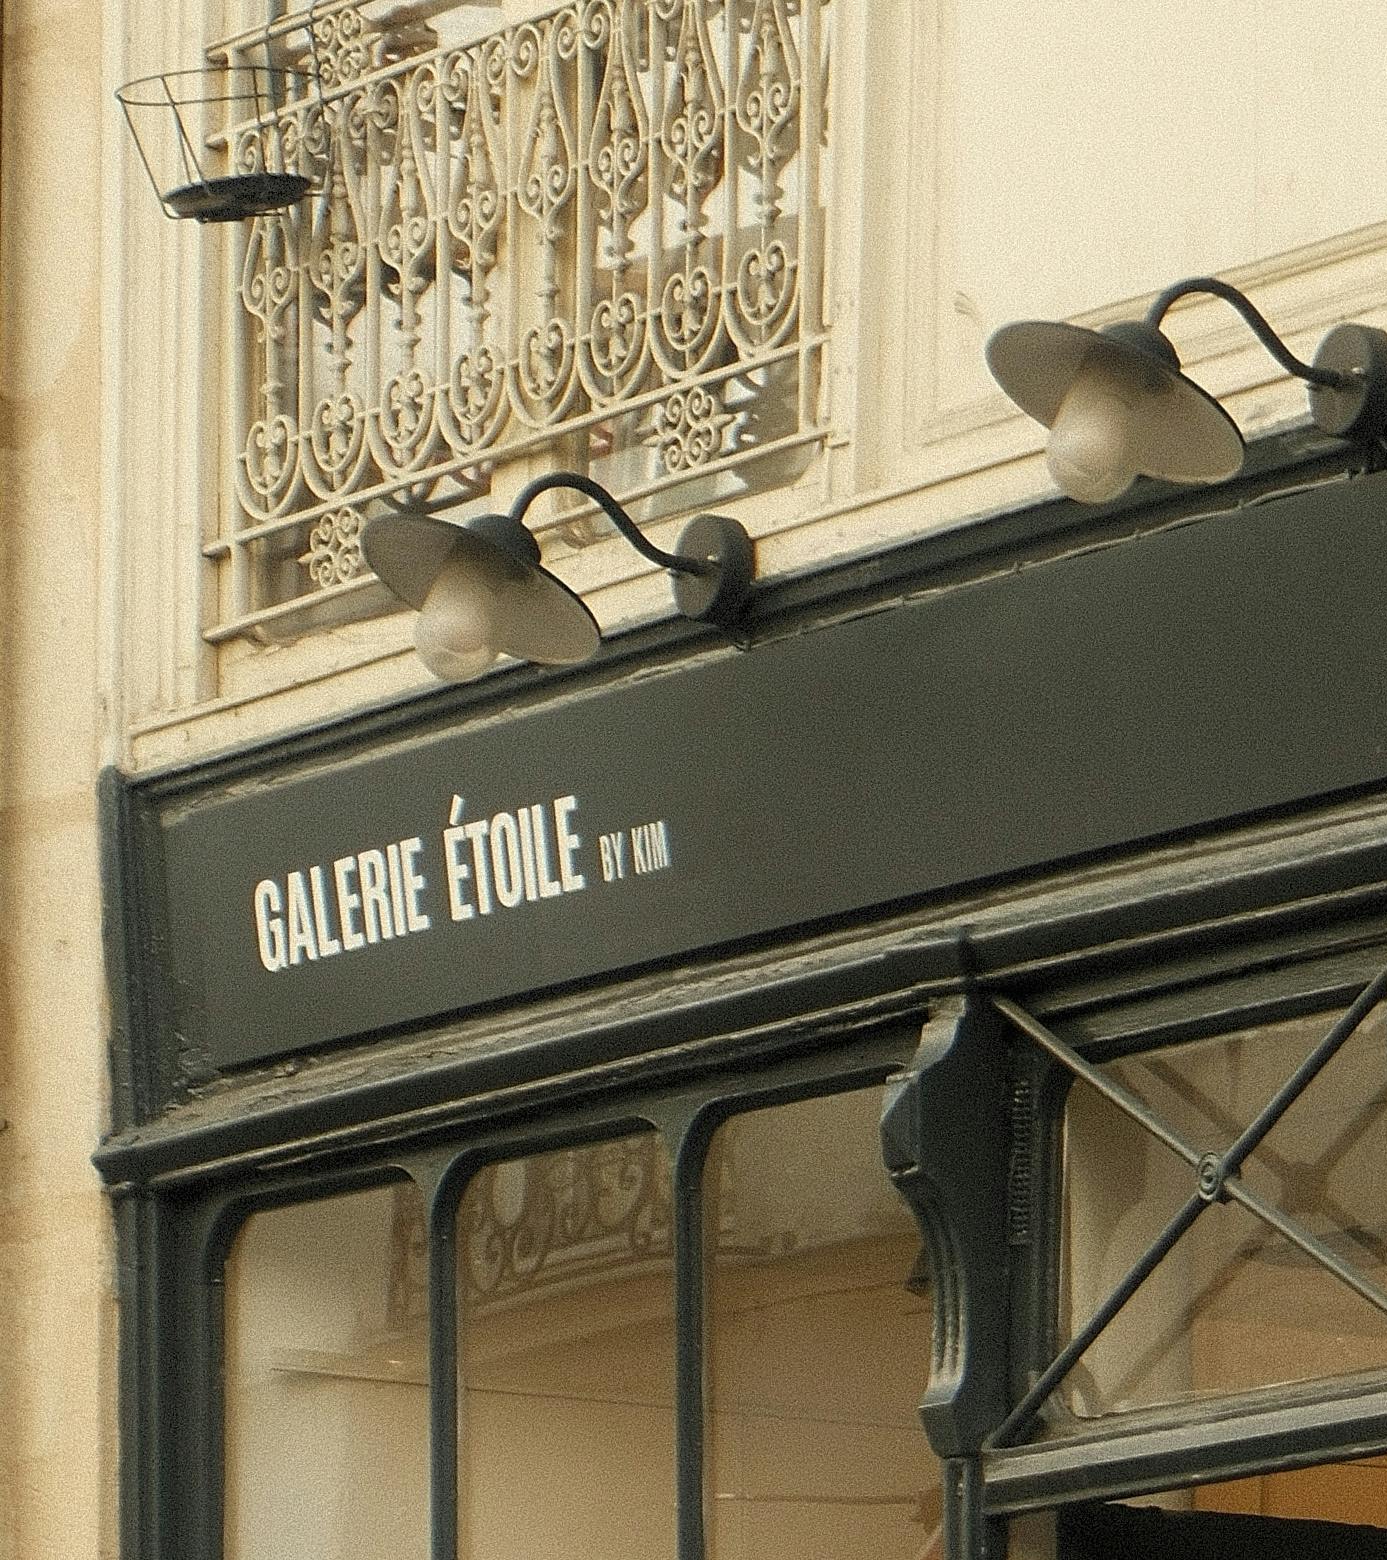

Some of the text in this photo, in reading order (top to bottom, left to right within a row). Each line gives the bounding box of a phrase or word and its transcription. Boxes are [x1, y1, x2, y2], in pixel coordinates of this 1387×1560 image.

[253, 794, 669, 972] GALERIE ÉTOILE BY KIM
